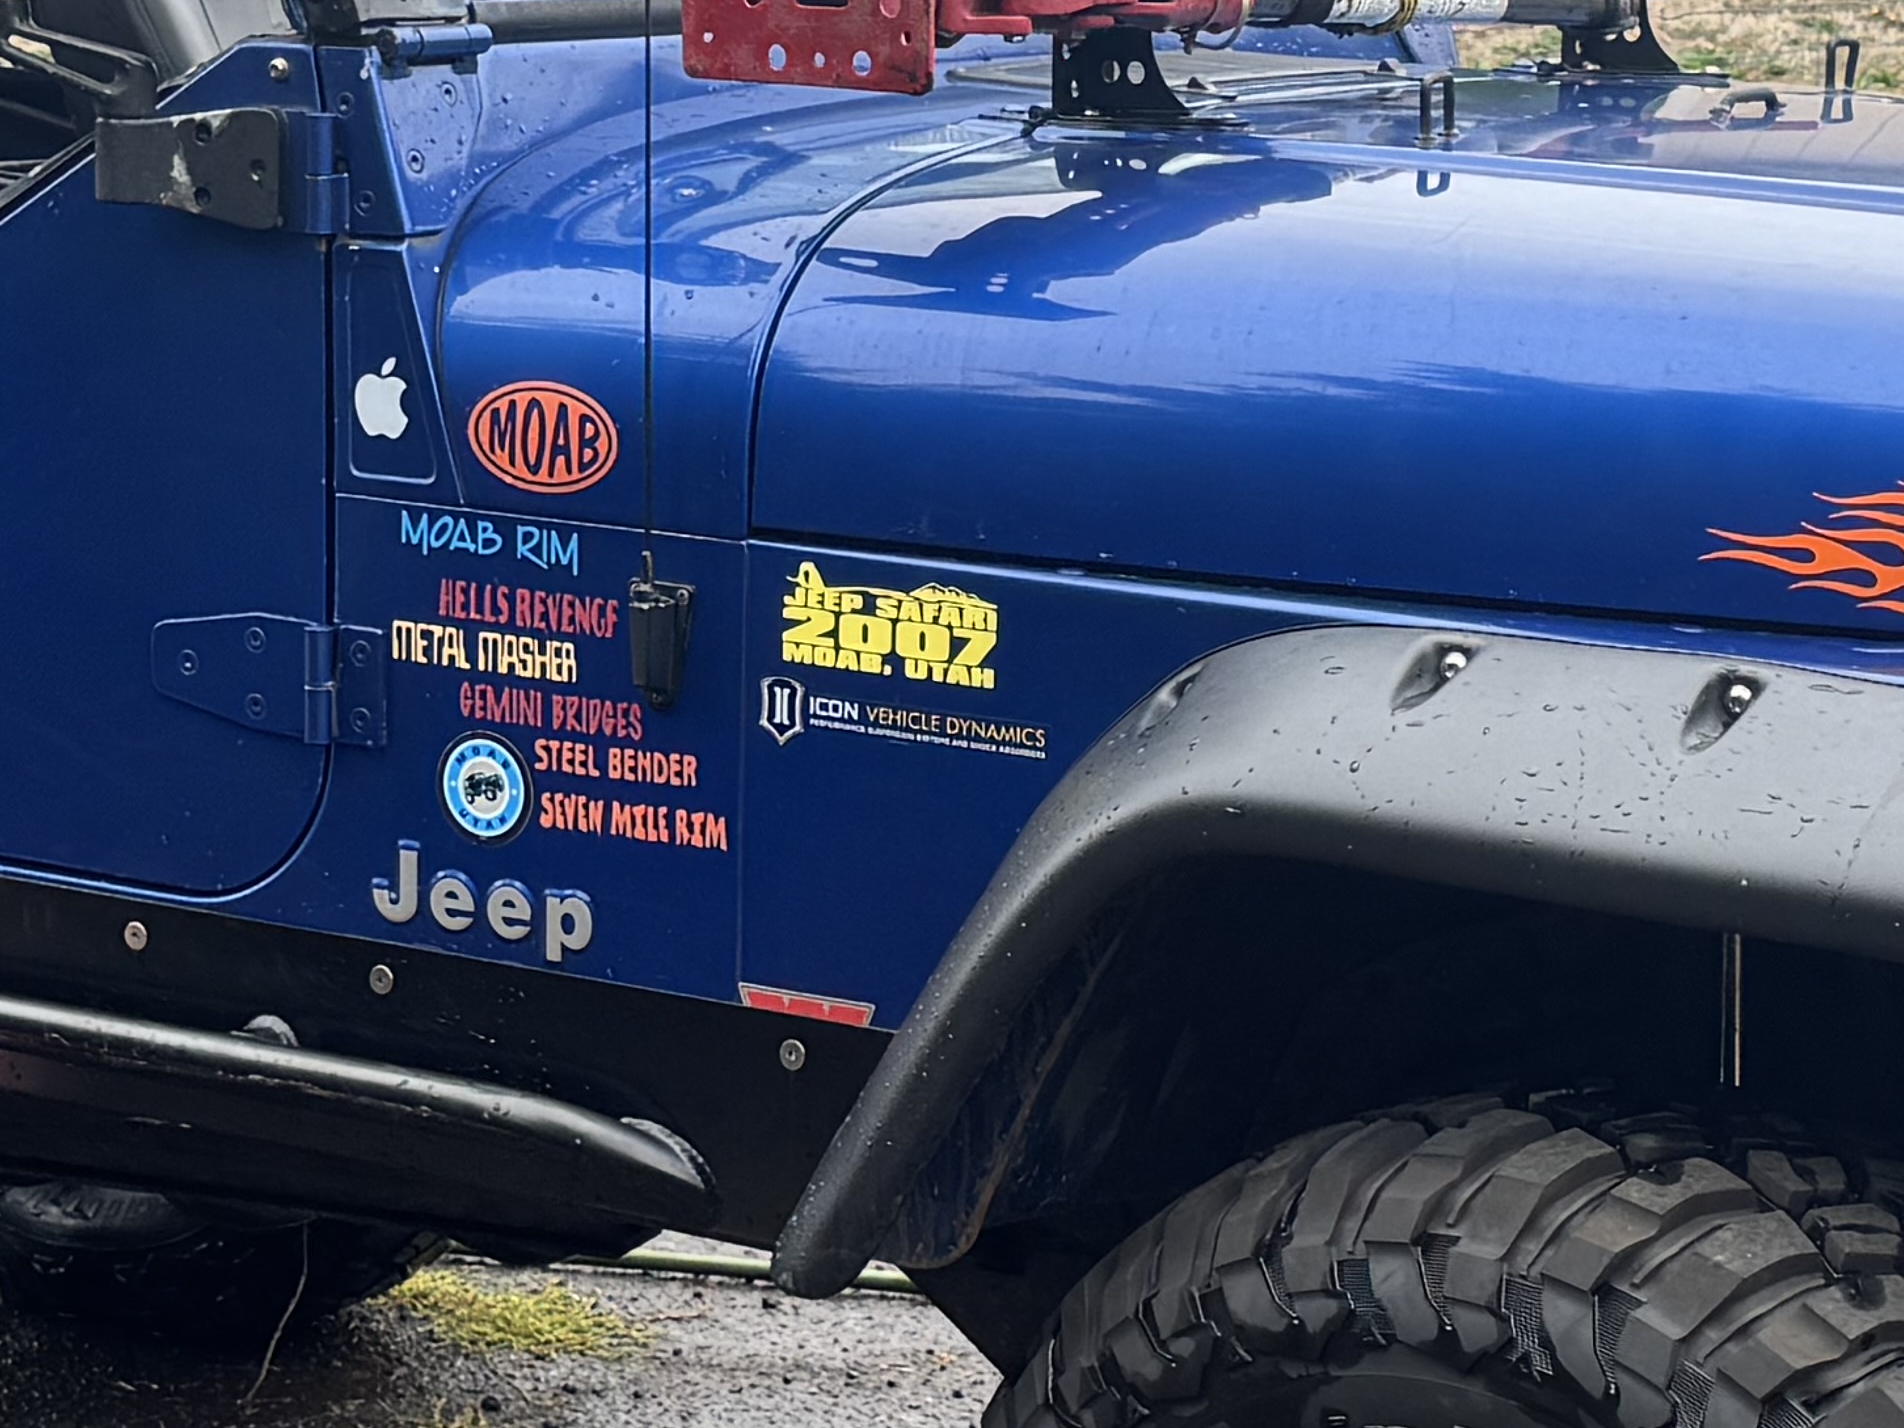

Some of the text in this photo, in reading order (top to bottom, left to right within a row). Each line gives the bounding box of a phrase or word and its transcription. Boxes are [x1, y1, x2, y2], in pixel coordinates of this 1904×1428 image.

[489, 396, 600, 479] MOAB
[401, 510, 578, 576] MOAB RIM
[438, 579, 619, 638] HELLS REVENGE
[782, 607, 997, 666] 2007
[783, 587, 998, 631] JEEP SAFARI
[392, 620, 577, 683] METAL MASHER
[904, 658, 995, 690] UTAH
[460, 681, 643, 741] GEMINI BRIDGES
[809, 696, 1046, 748] ICON VEHICLE DYNAMICS
[454, 745, 511, 771] MOAB
[534, 738, 698, 787] STEEL BENDER
[539, 792, 728, 852] SEVEN MILE RIM
[371, 839, 593, 962] Jeep
